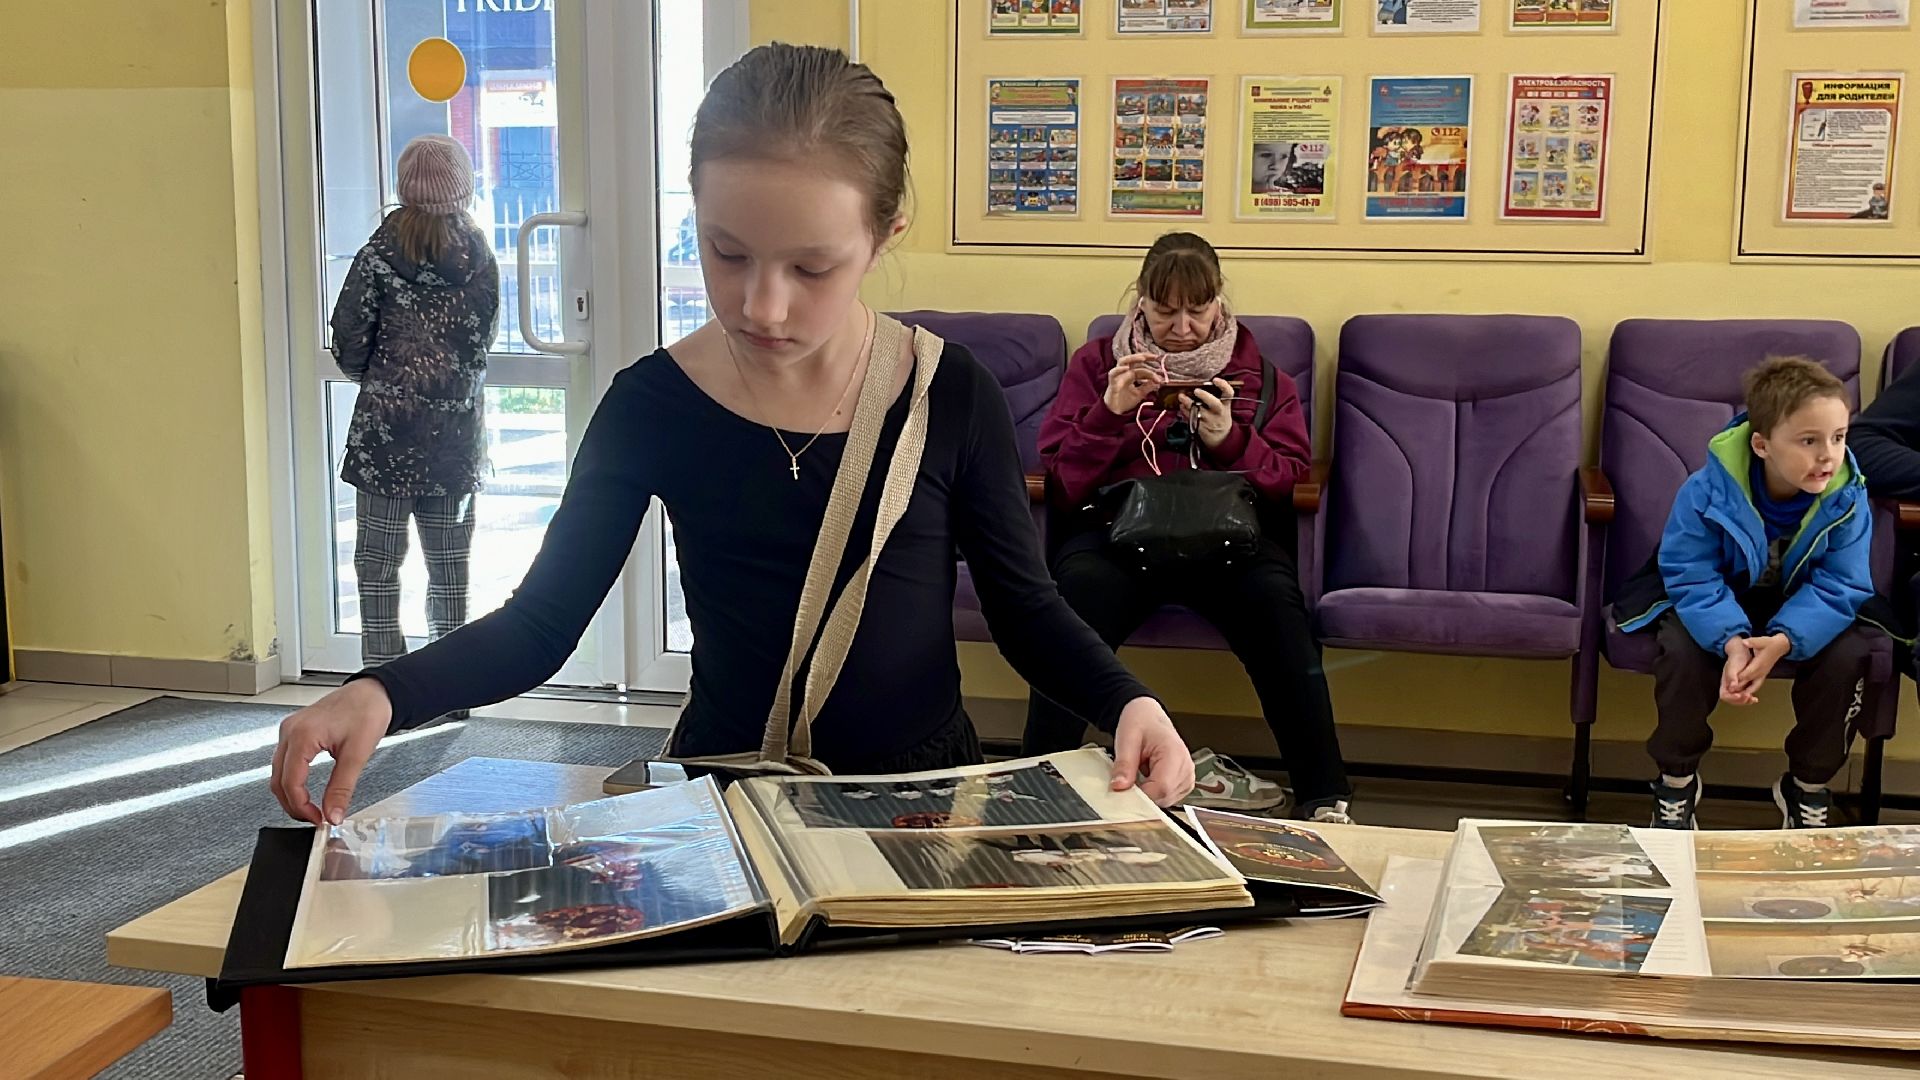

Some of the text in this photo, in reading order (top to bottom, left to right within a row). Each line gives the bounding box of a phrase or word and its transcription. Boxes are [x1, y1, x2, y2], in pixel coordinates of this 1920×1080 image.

[1518, 79, 1605, 87] ЭЛЕКТРОБЕЗОПАСНОСТЬ
[1823, 83, 1891, 91] ИНФОРМАЦИЯ
[1816, 93, 1836, 101] ДЛЯ
[1443, 127, 1460, 136] 112
[1310, 144, 1324, 152] 112
